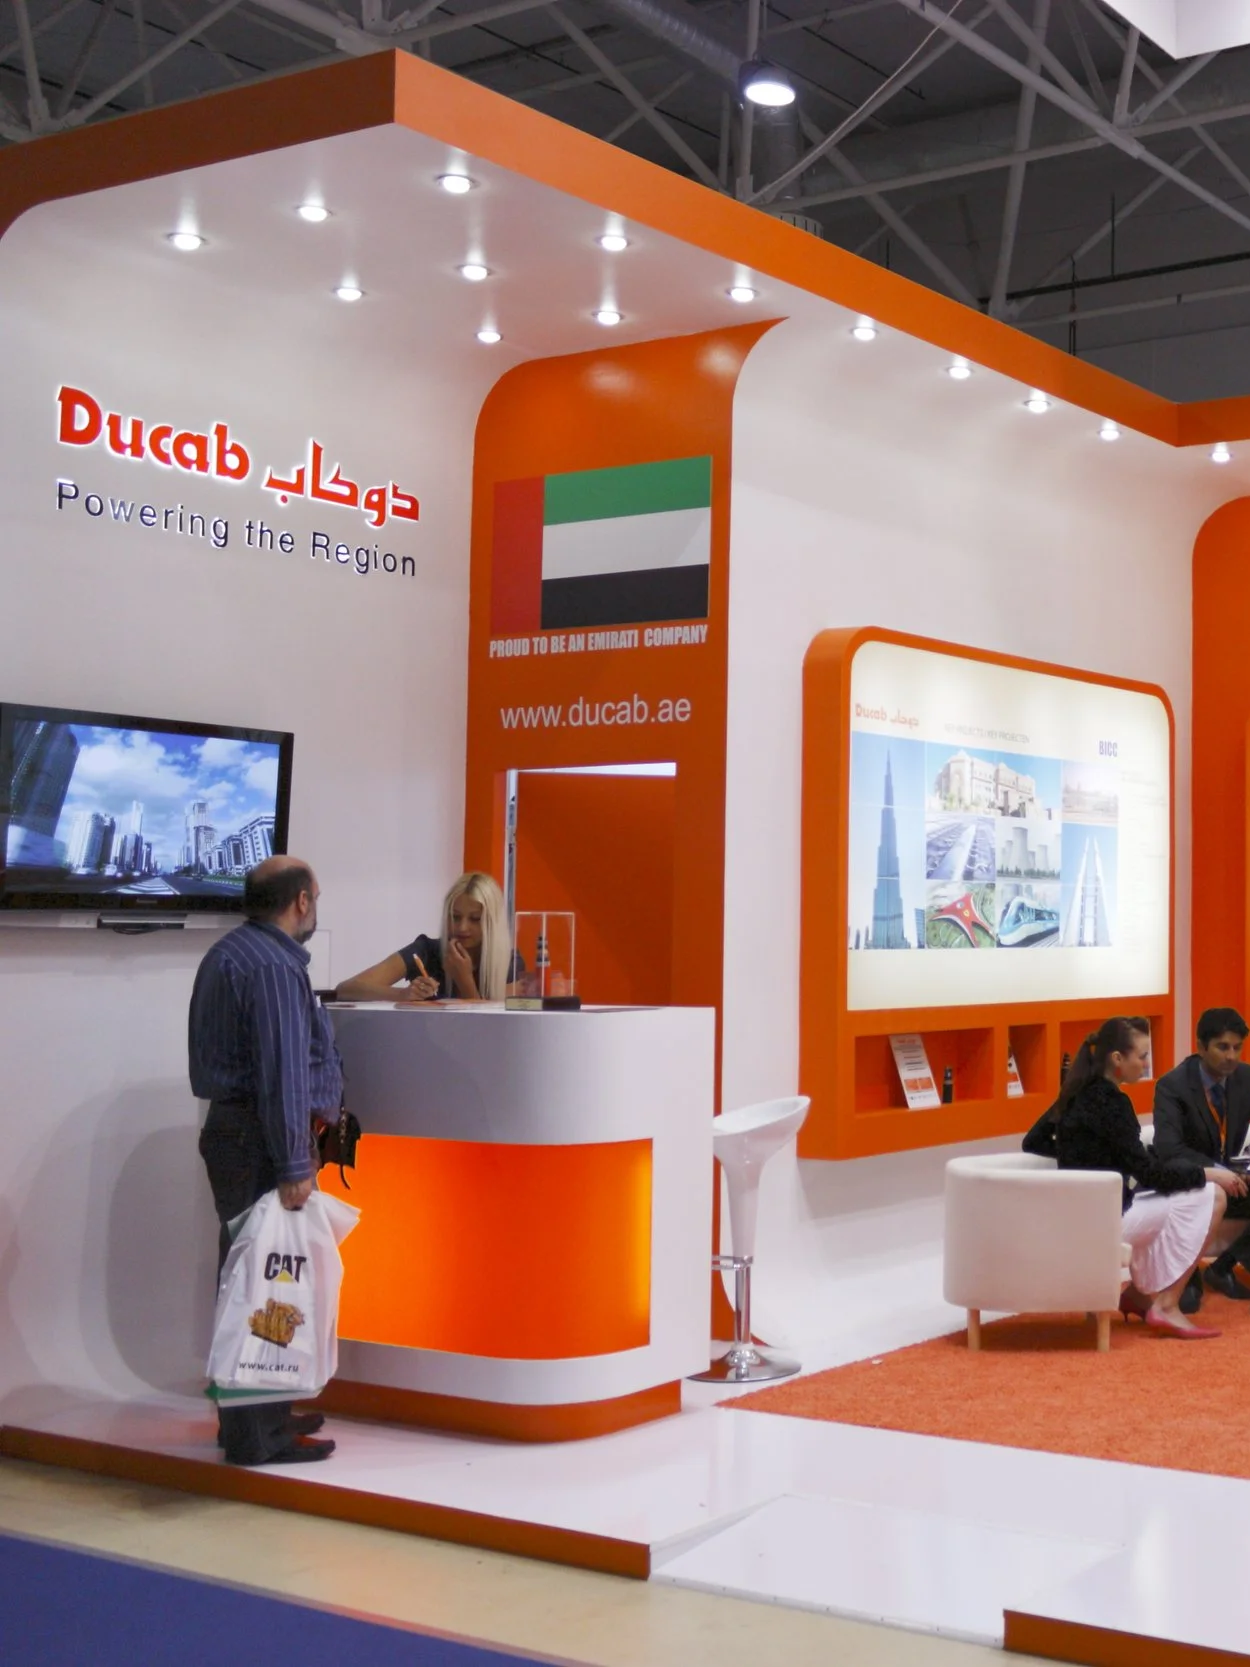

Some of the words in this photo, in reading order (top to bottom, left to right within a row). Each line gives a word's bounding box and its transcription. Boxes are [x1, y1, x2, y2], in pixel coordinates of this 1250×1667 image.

[57, 384, 250, 481] Ducab
[262, 438, 421, 527] دوكاب
[56, 480, 229, 548] Powering
[245, 520, 296, 554] the
[310, 531, 416, 576] Region
[489, 639, 529, 658] PROUD
[532, 636, 548, 655] TO
[550, 635, 566, 653] BE
[568, 633, 585, 652] AN
[587, 629, 639, 651] EMIRATI
[643, 625, 708, 647] COMPANY
[500, 693, 692, 729] www.ducab.ae
[1098, 740, 1118, 758] BICC
[264, 1252, 307, 1283] CAT
[239, 1361, 299, 1373] www.cat.ru
